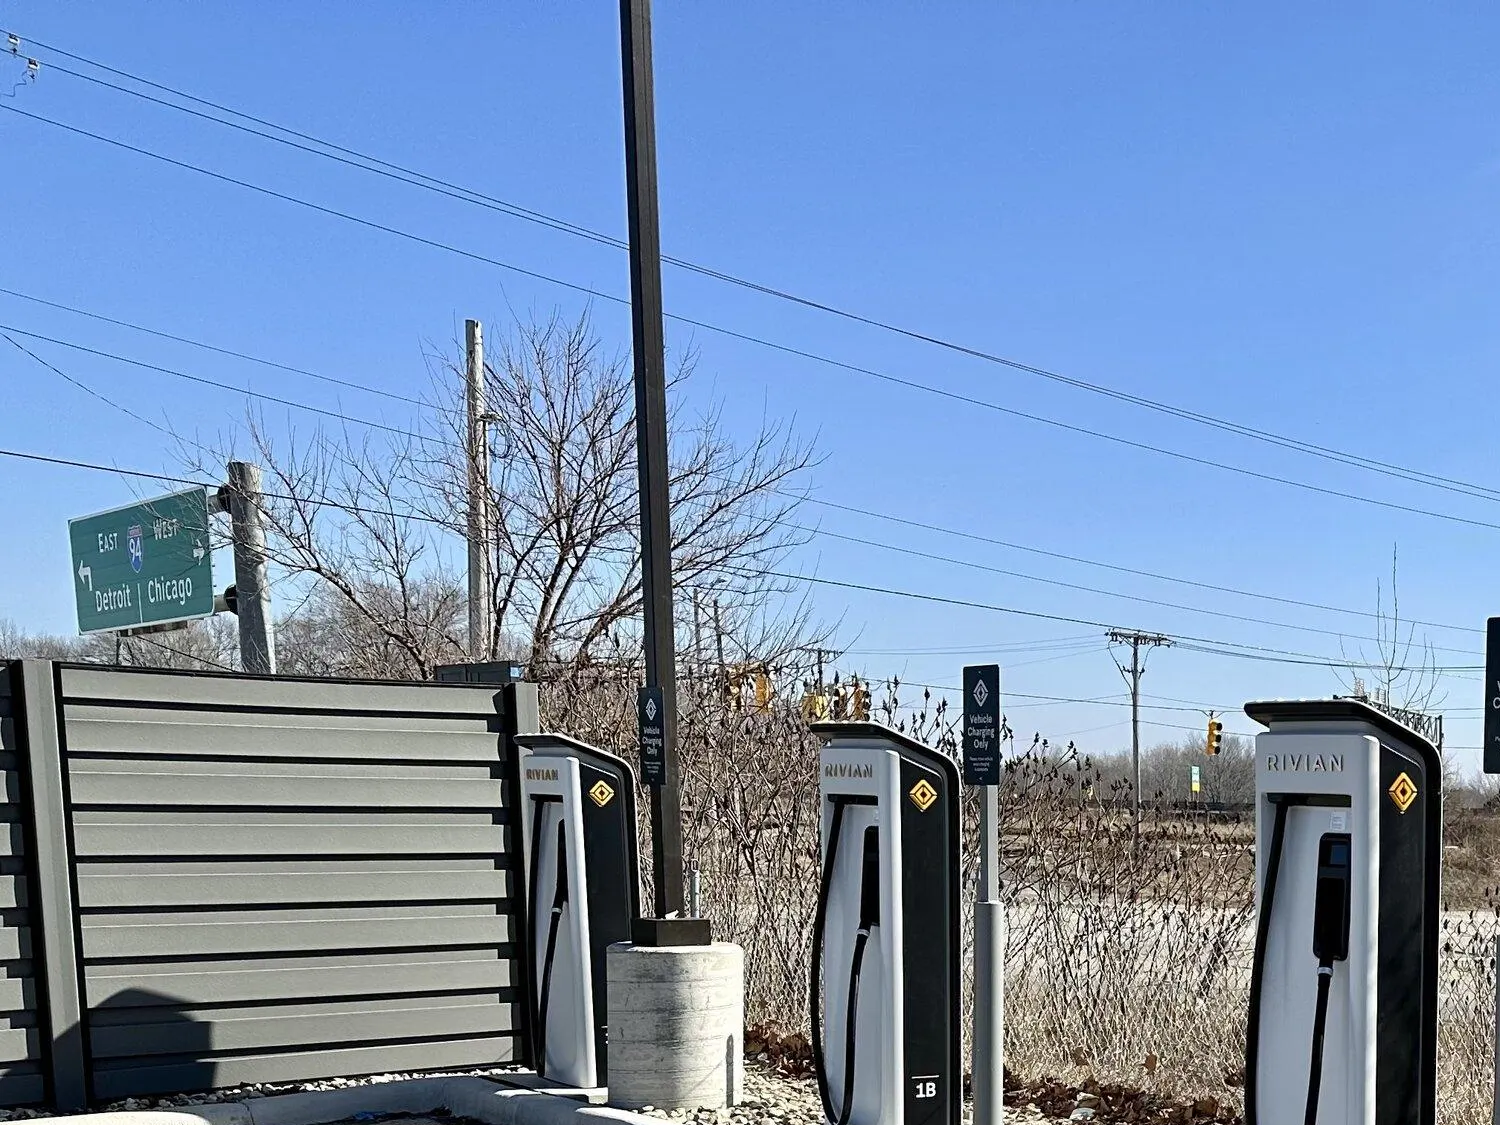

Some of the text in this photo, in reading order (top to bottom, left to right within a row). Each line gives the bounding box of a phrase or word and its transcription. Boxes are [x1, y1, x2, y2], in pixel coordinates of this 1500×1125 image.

[152, 518, 179, 541] WEST
[98, 533, 118, 553] EAST
[129, 537, 142, 562] 94
[95, 583, 132, 612] Detroit
[148, 576, 193, 606] Chicago
[969, 714, 993, 724] Vehicle
[967, 726, 995, 739] Charging
[973, 738, 989, 751] Only
[824, 762, 873, 779] RIVIAN
[1266, 753, 1345, 773] RIVIAN
[525, 768, 559, 780] RIVIAN
[915, 1082, 937, 1099] 1B
